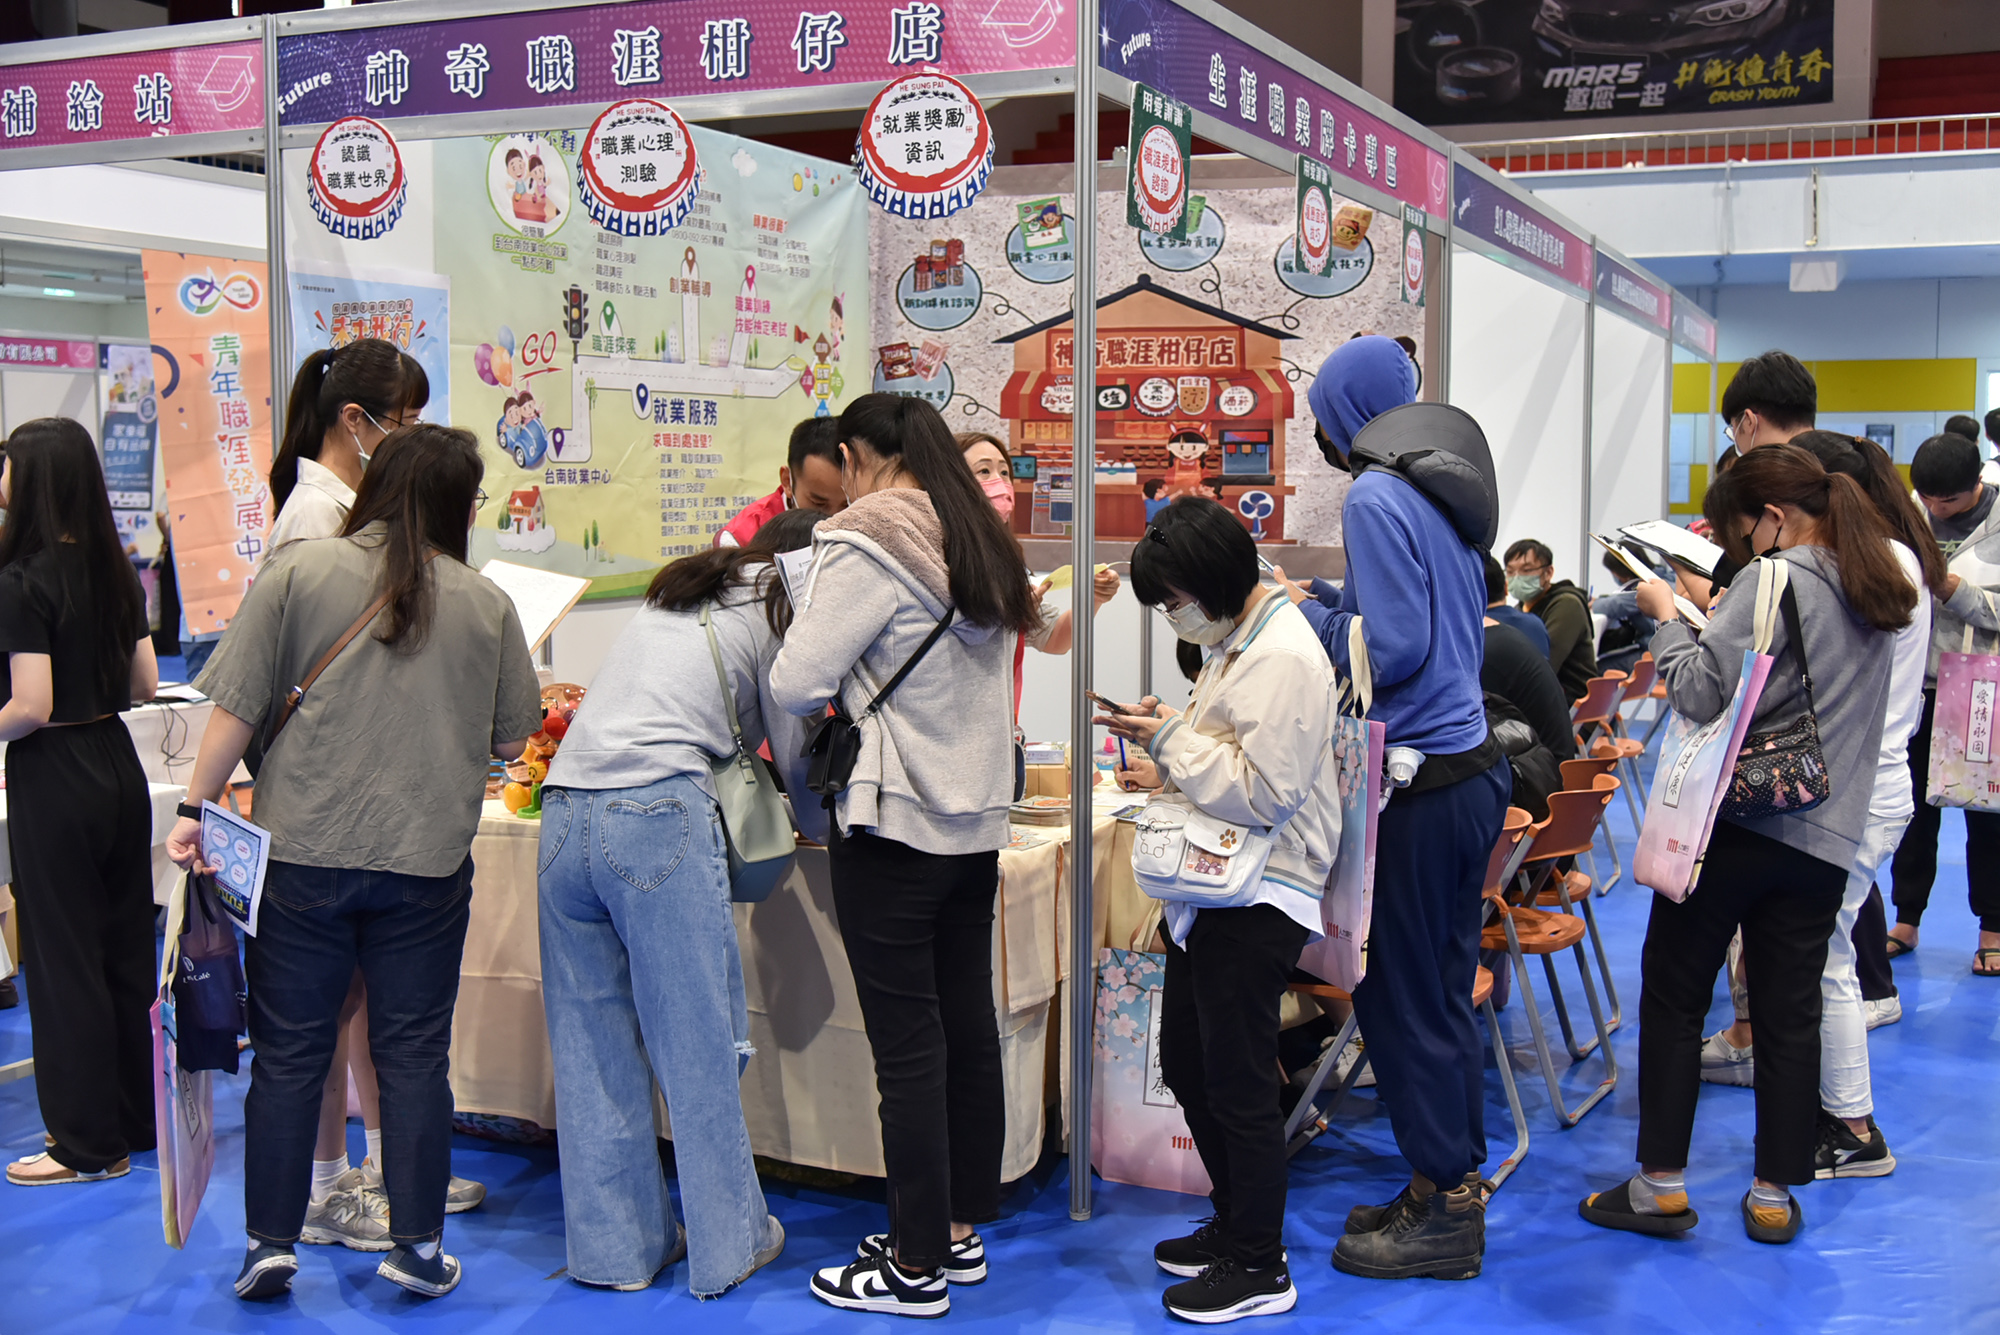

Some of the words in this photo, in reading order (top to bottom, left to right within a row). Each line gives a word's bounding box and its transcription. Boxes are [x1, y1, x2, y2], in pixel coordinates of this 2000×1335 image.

[365, 2, 944, 106] 神奇職涯柑仔店
[1120, 32, 1151, 65] Future
[1543, 62, 1643, 88] MARS
[1, 72, 172, 138] 補給站
[277, 70, 333, 115] Future
[1564, 82, 1667, 111] 邀您一起
[1758, 85, 1800, 100] YOUTH
[882, 107, 965, 134] 就業獎勵
[1208, 52, 1398, 189] 生涯職業牌卡專區
[341, 145, 371, 163] 認識
[601, 132, 675, 156] 職業心理
[904, 140, 944, 164] 資訊
[327, 169, 388, 189] 職業世界
[620, 162, 657, 183] 測驗
[521, 330, 557, 367] GO
[592, 334, 637, 356] 職涯探索
[653, 397, 718, 426] 就業服務
[211, 335, 265, 588] 青年職涯發展中
[544, 467, 612, 485] 台南就業中心
[1171, 1135, 1193, 1150] 1111
